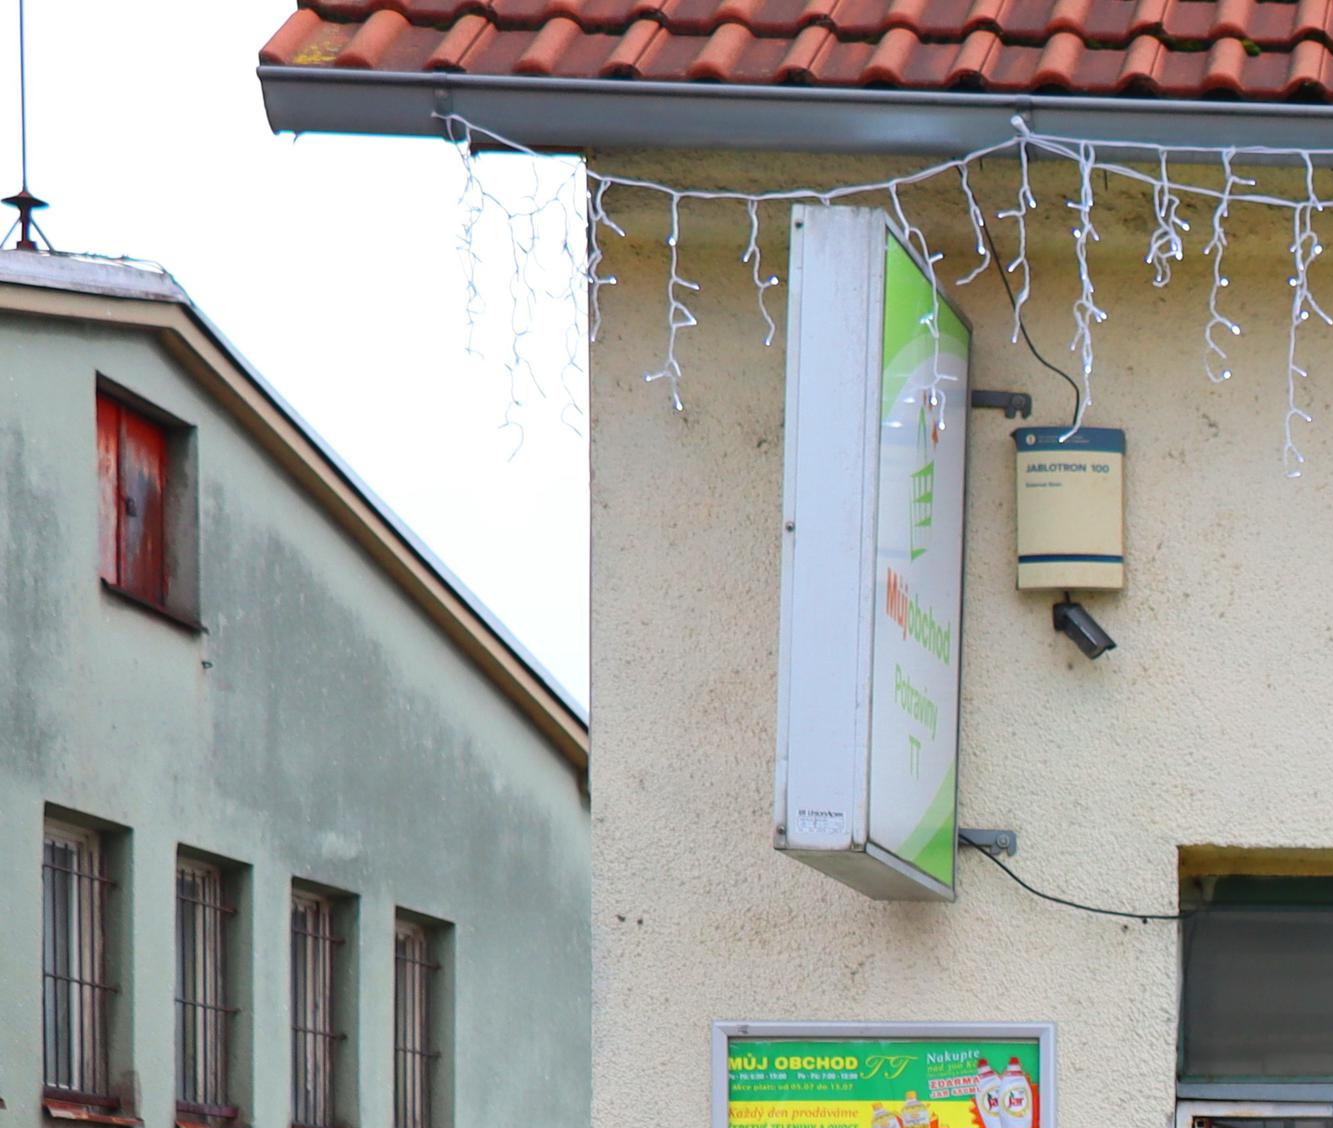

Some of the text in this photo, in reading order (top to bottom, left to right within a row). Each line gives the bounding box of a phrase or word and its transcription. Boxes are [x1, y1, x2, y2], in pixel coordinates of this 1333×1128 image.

[1091, 465, 1110, 473] 100
[895, 663, 939, 741] Potraviny
[729, 1052, 768, 1071] MŮJ
[774, 1056, 859, 1071] OBCHOD
[926, 1050, 980, 1065] Nakupte
[768, 1107, 788, 1119] den
